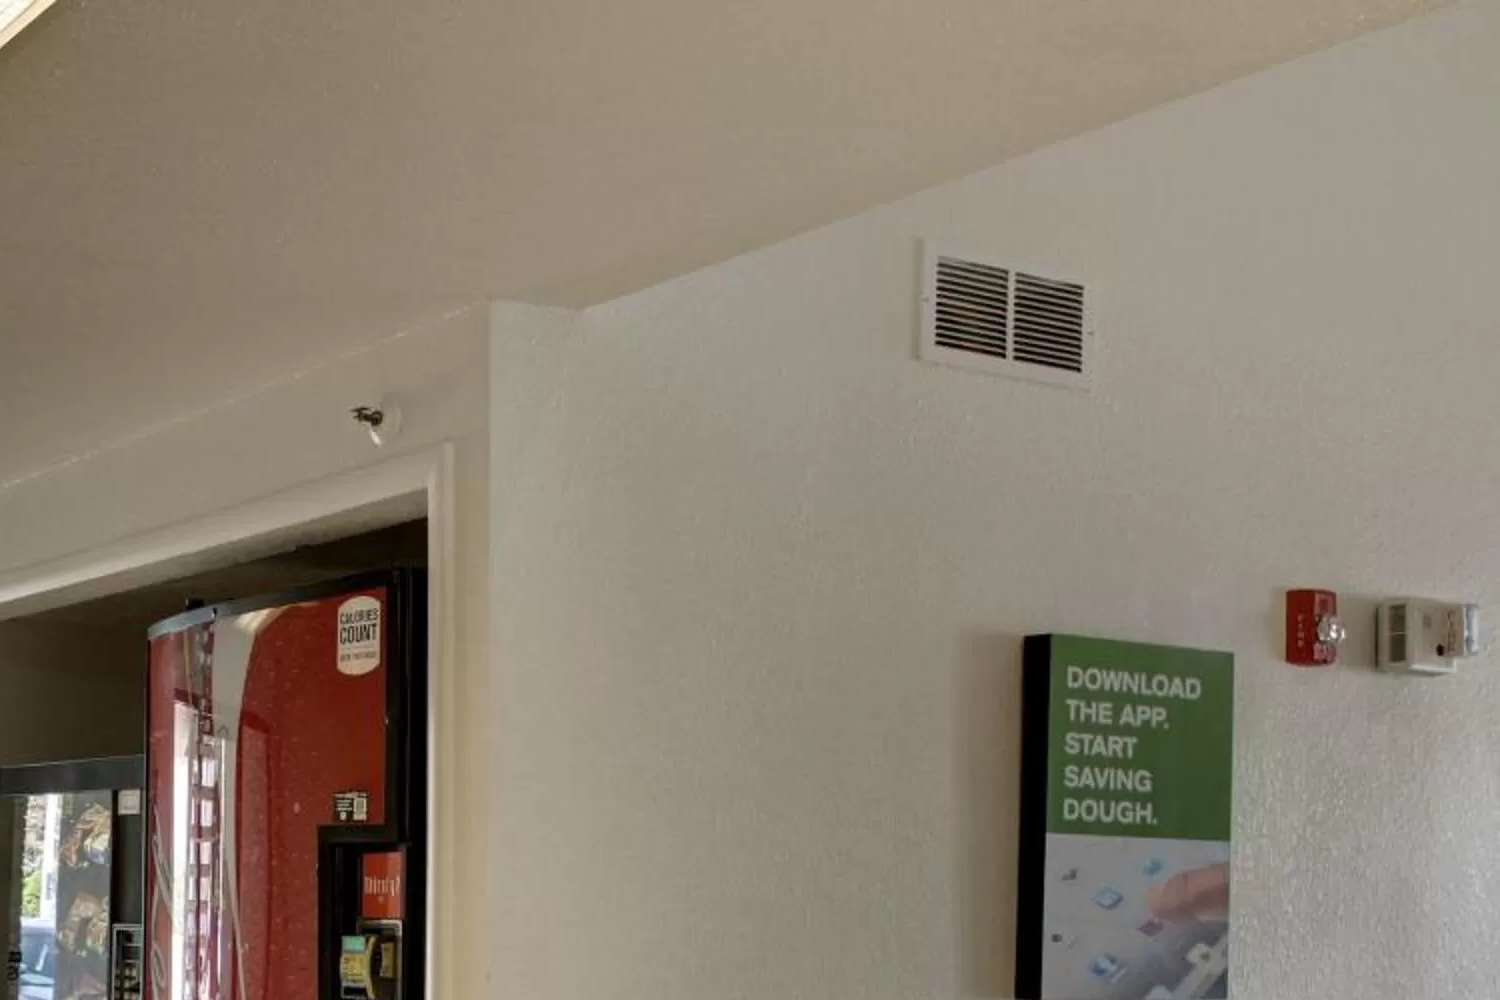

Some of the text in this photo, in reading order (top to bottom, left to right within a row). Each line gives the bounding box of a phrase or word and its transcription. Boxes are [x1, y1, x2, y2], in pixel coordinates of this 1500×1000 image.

[340, 623, 377, 645] COUNT
[1066, 665, 1202, 700] DOWNLOAD
[1065, 699, 1170, 730] THE APP.
[1064, 732, 1139, 760] START
[1063, 764, 1155, 793] SAVING
[1062, 798, 1158, 825] DOUGH.
